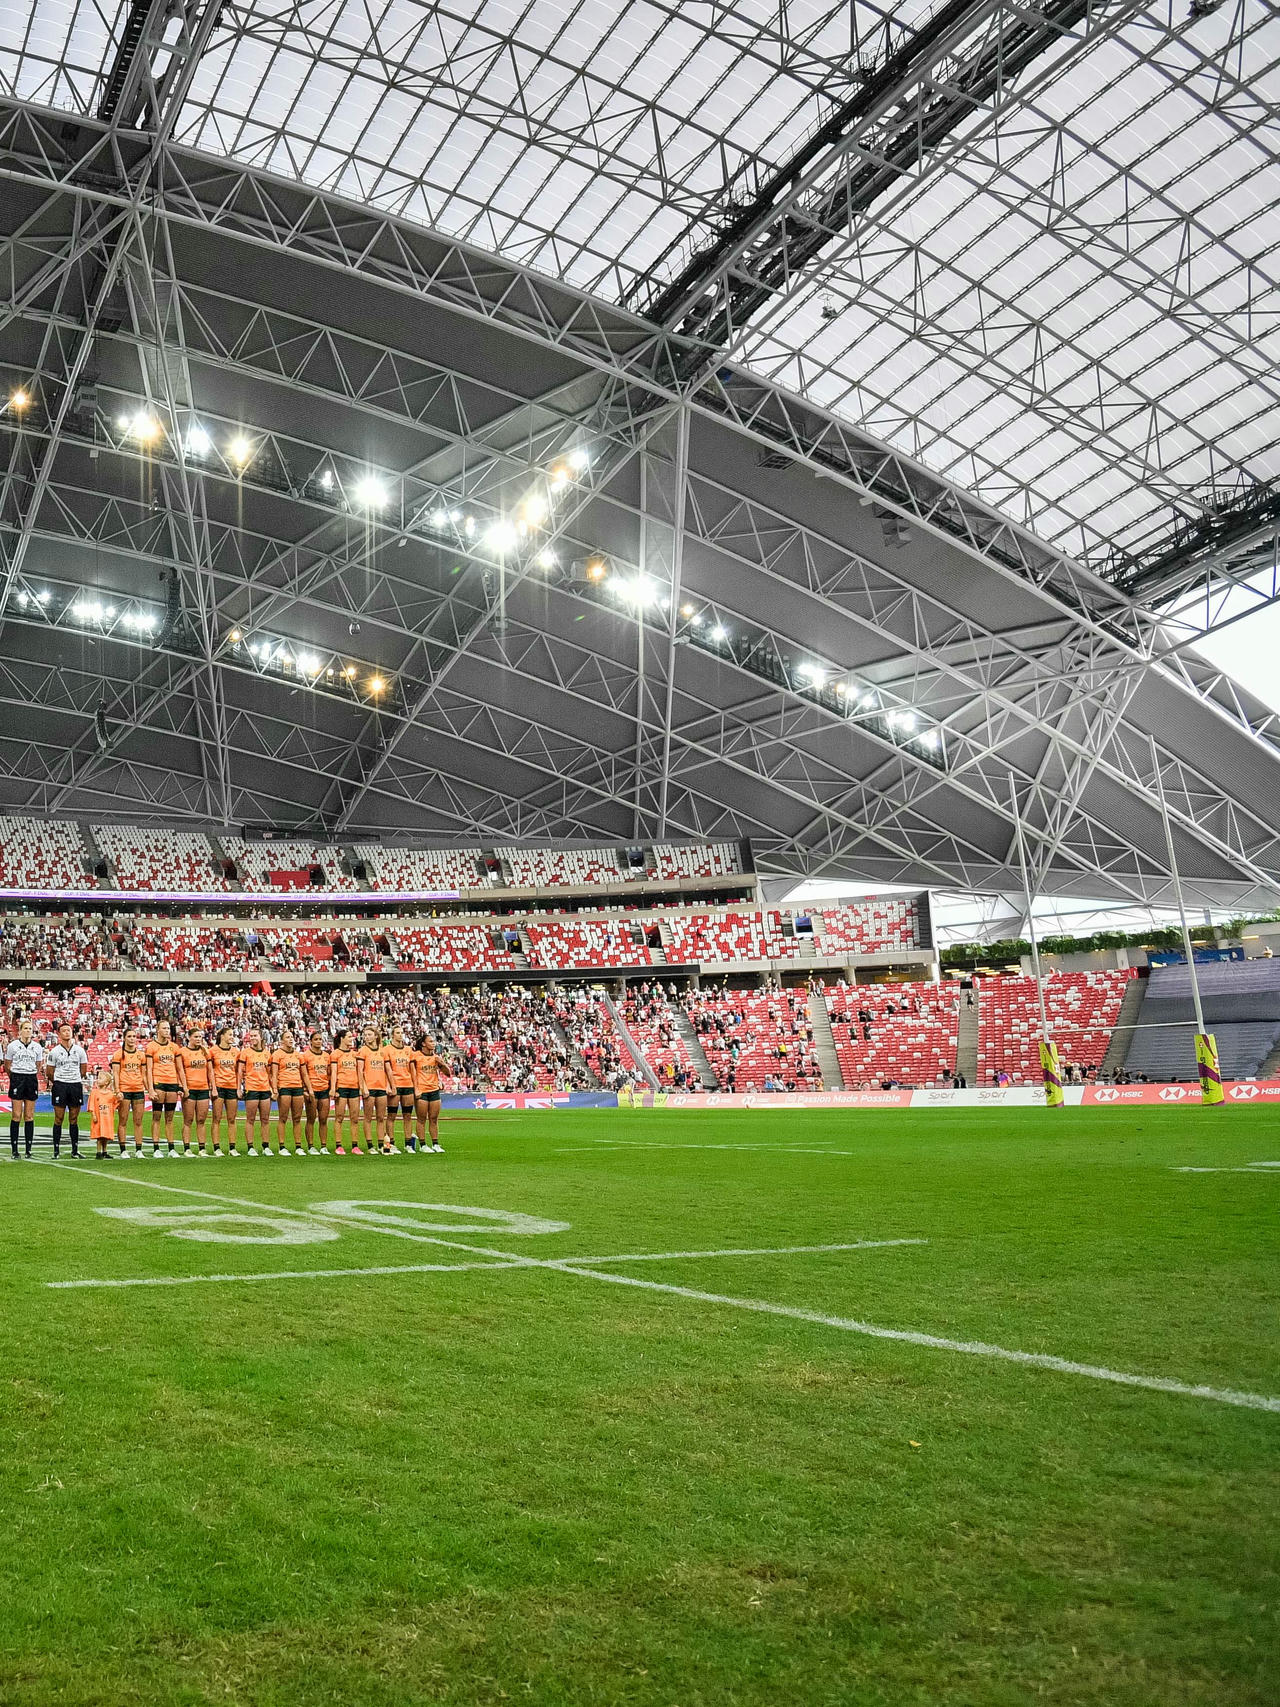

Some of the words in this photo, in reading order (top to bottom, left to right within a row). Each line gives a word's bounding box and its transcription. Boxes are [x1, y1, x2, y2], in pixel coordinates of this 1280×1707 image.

[798, 1094, 831, 1104] Passion
[833, 1094, 858, 1103] Made
[860, 1094, 900, 1102] Possible
[928, 1092, 955, 1100] Sport
[978, 1091, 1008, 1100] Sport
[92, 1200, 570, 1245] 50
